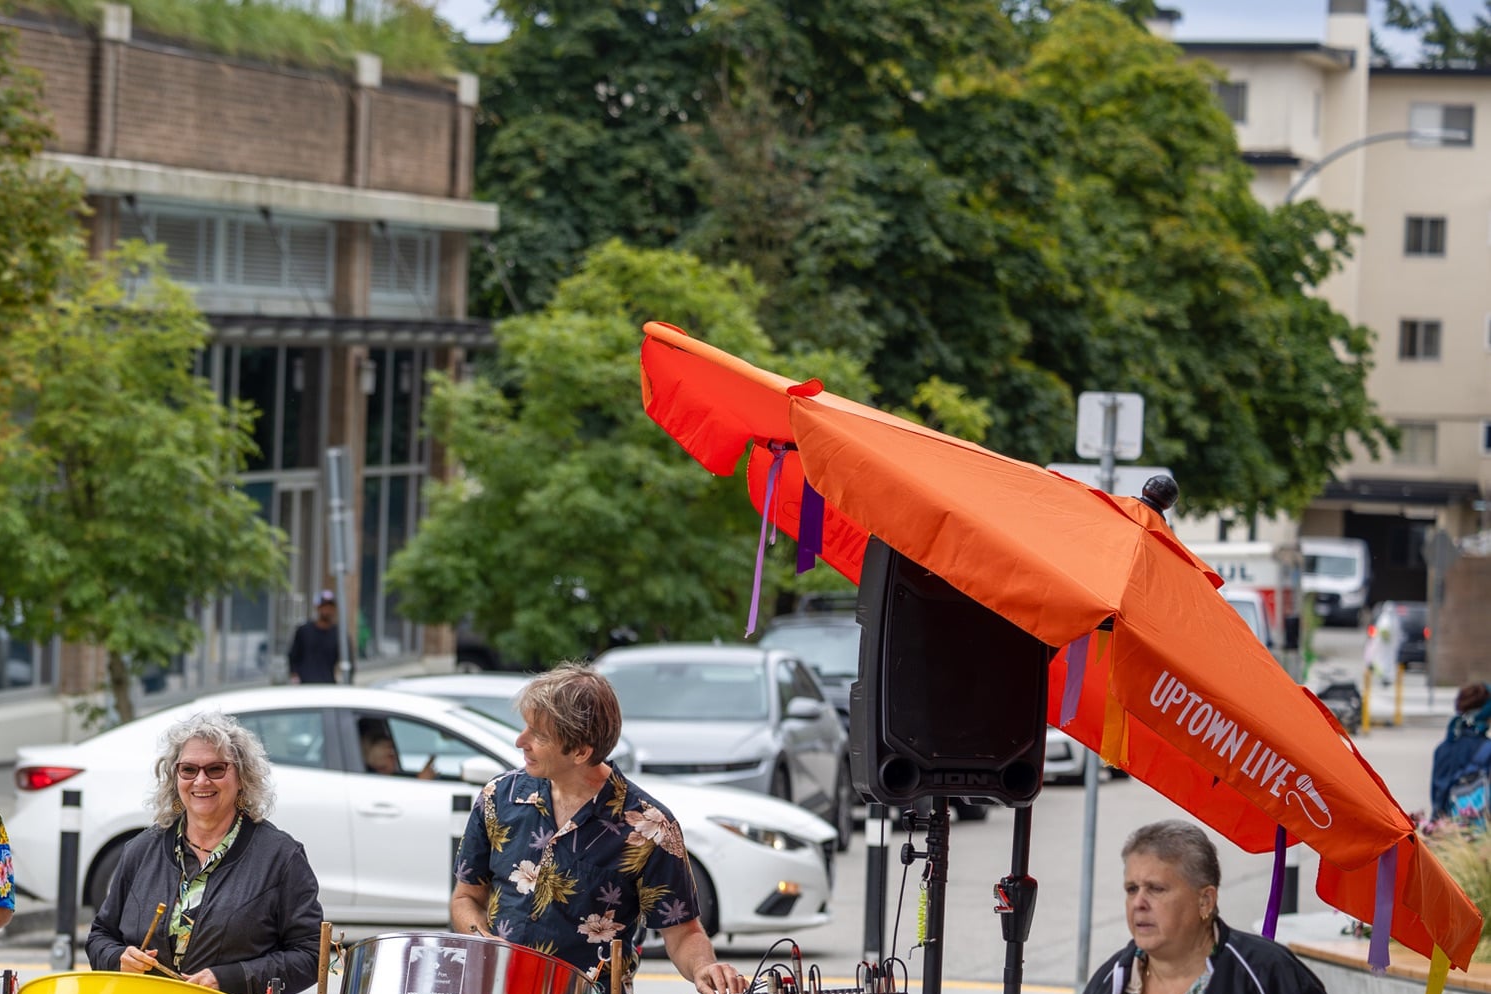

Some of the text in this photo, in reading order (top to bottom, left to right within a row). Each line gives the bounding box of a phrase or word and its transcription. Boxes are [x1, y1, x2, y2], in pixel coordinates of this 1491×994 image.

[1150, 670, 1297, 798] UPTOWN LIVE
[933, 772, 989, 785] ION
